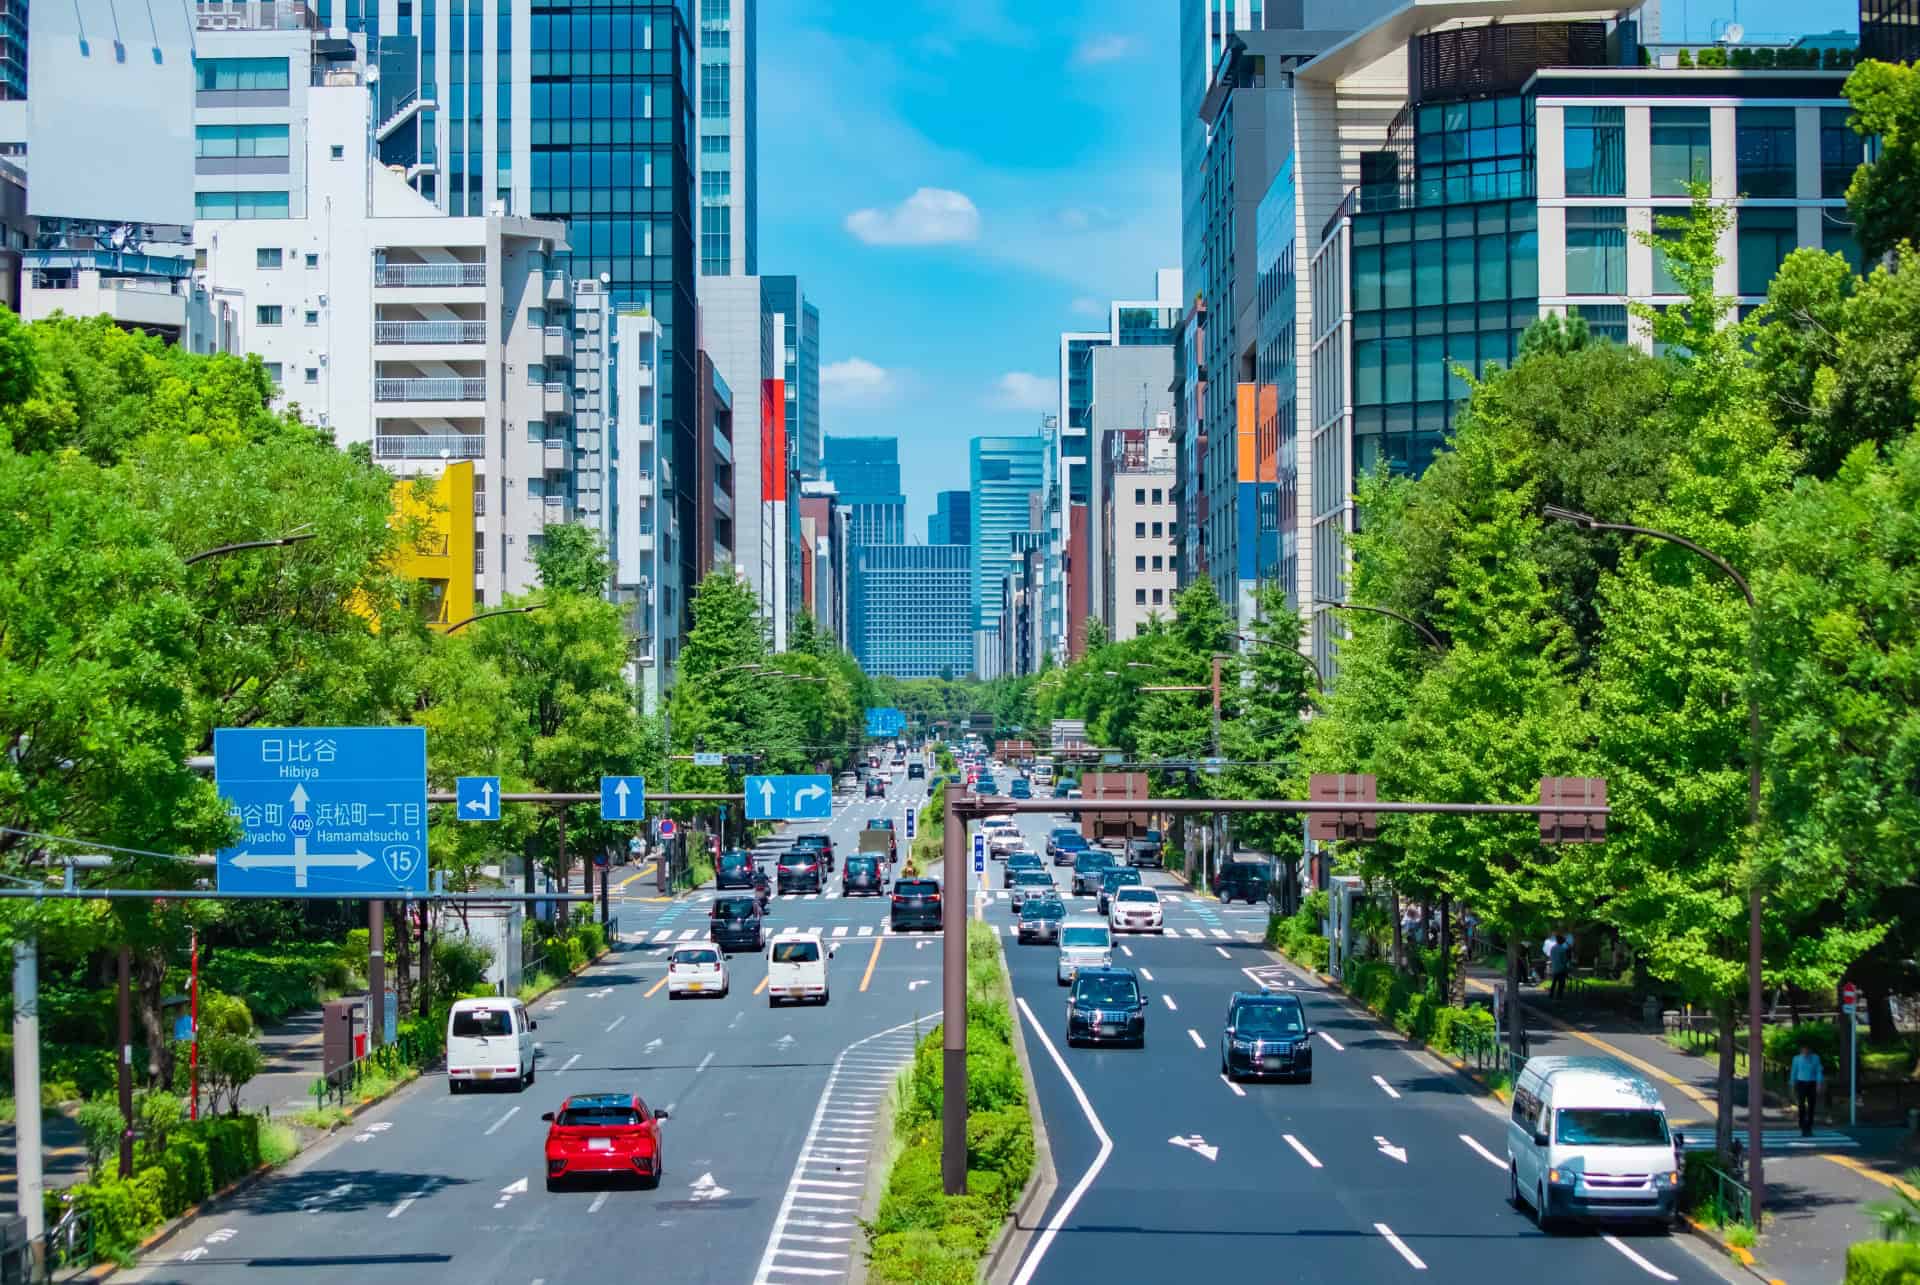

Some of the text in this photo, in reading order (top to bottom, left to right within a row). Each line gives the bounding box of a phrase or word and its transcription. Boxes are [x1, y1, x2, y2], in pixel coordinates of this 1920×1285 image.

[262, 739, 336, 762] 日比谷
[279, 765, 320, 780] Hibiya
[315, 802, 419, 826] 浜松町一丁目
[291, 820, 311, 831] 409
[317, 830, 420, 842] Hamamatsucho 1
[390, 851, 411, 871] 15
